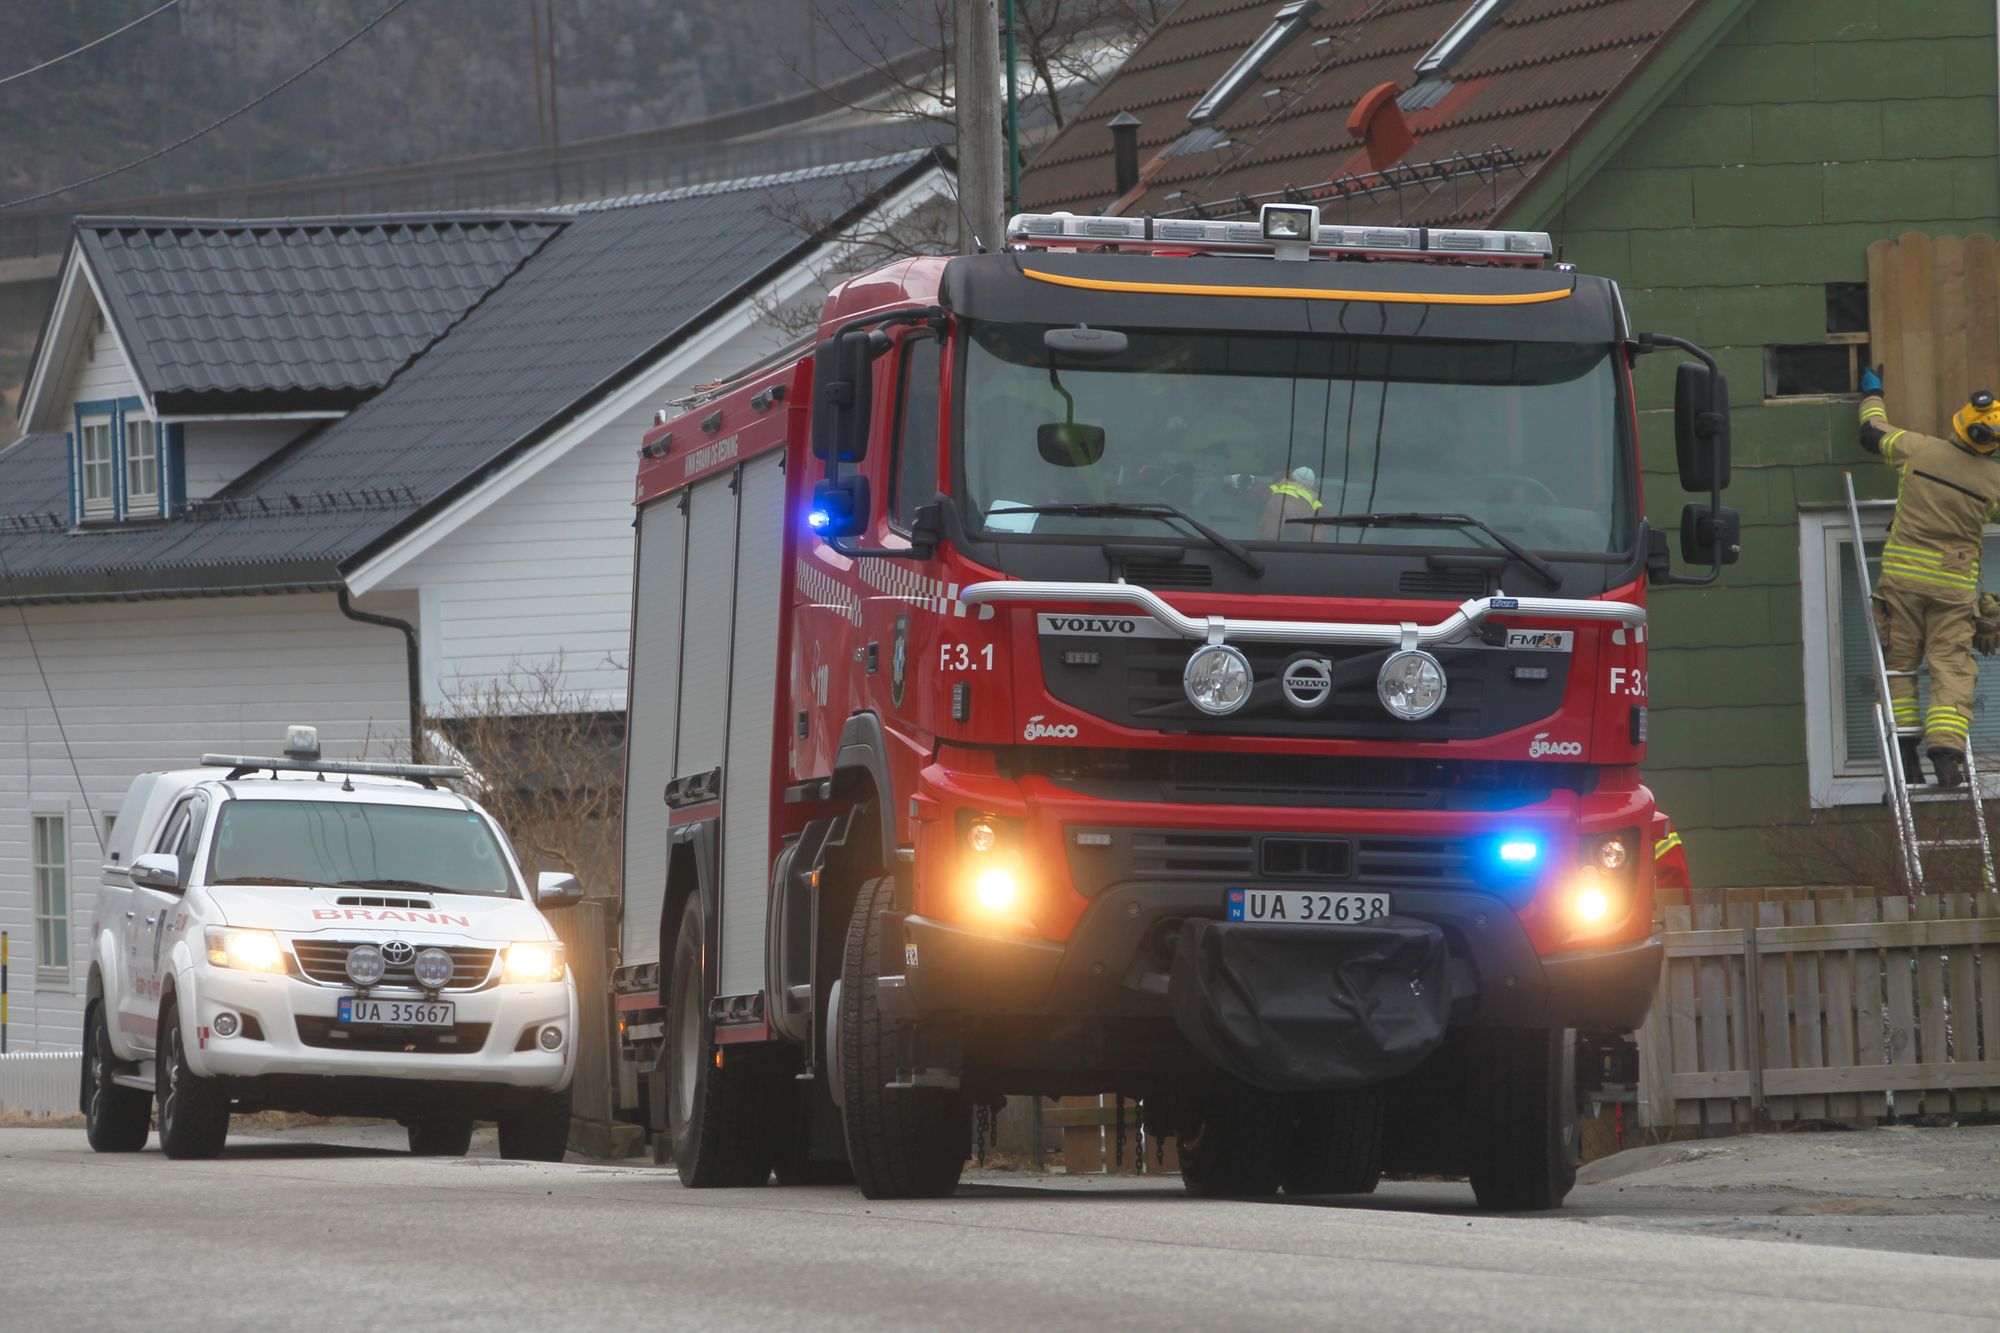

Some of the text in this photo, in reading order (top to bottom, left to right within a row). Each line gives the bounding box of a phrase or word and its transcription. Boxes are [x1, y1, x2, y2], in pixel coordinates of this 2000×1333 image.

[1046, 617, 1136, 634] VOLVO
[940, 642, 994, 671] F.3.1
[1286, 679, 1329, 688] VOLVO
[1610, 667, 1648, 696] F.3.
[311, 908, 471, 928] BRANN
[1250, 893, 1287, 920] UA
[1300, 895, 1384, 922] 32638
[355, 1002, 381, 1021] UA
[390, 1003, 450, 1024] 35667
